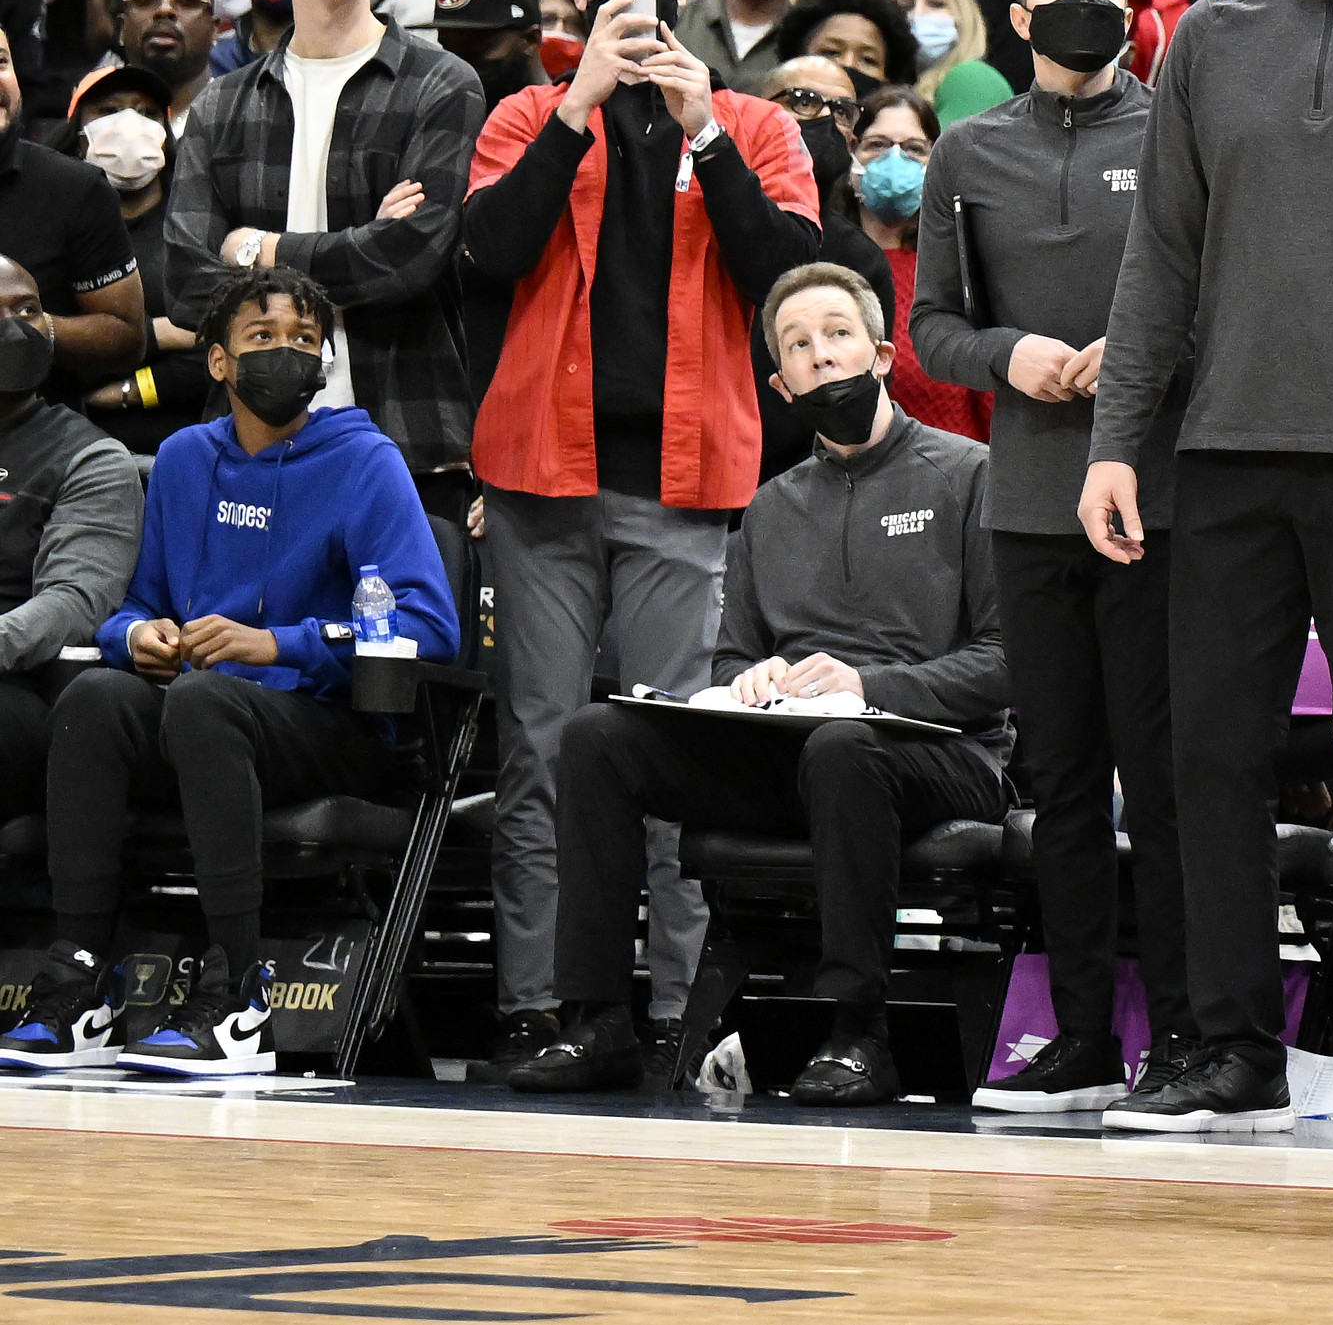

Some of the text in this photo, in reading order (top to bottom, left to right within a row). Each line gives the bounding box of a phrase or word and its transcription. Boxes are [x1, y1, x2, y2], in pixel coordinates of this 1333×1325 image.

[1102, 168, 1139, 182] CHIC
[881, 509, 935, 528] CHICAGO
[887, 520, 925, 537] BULLS
